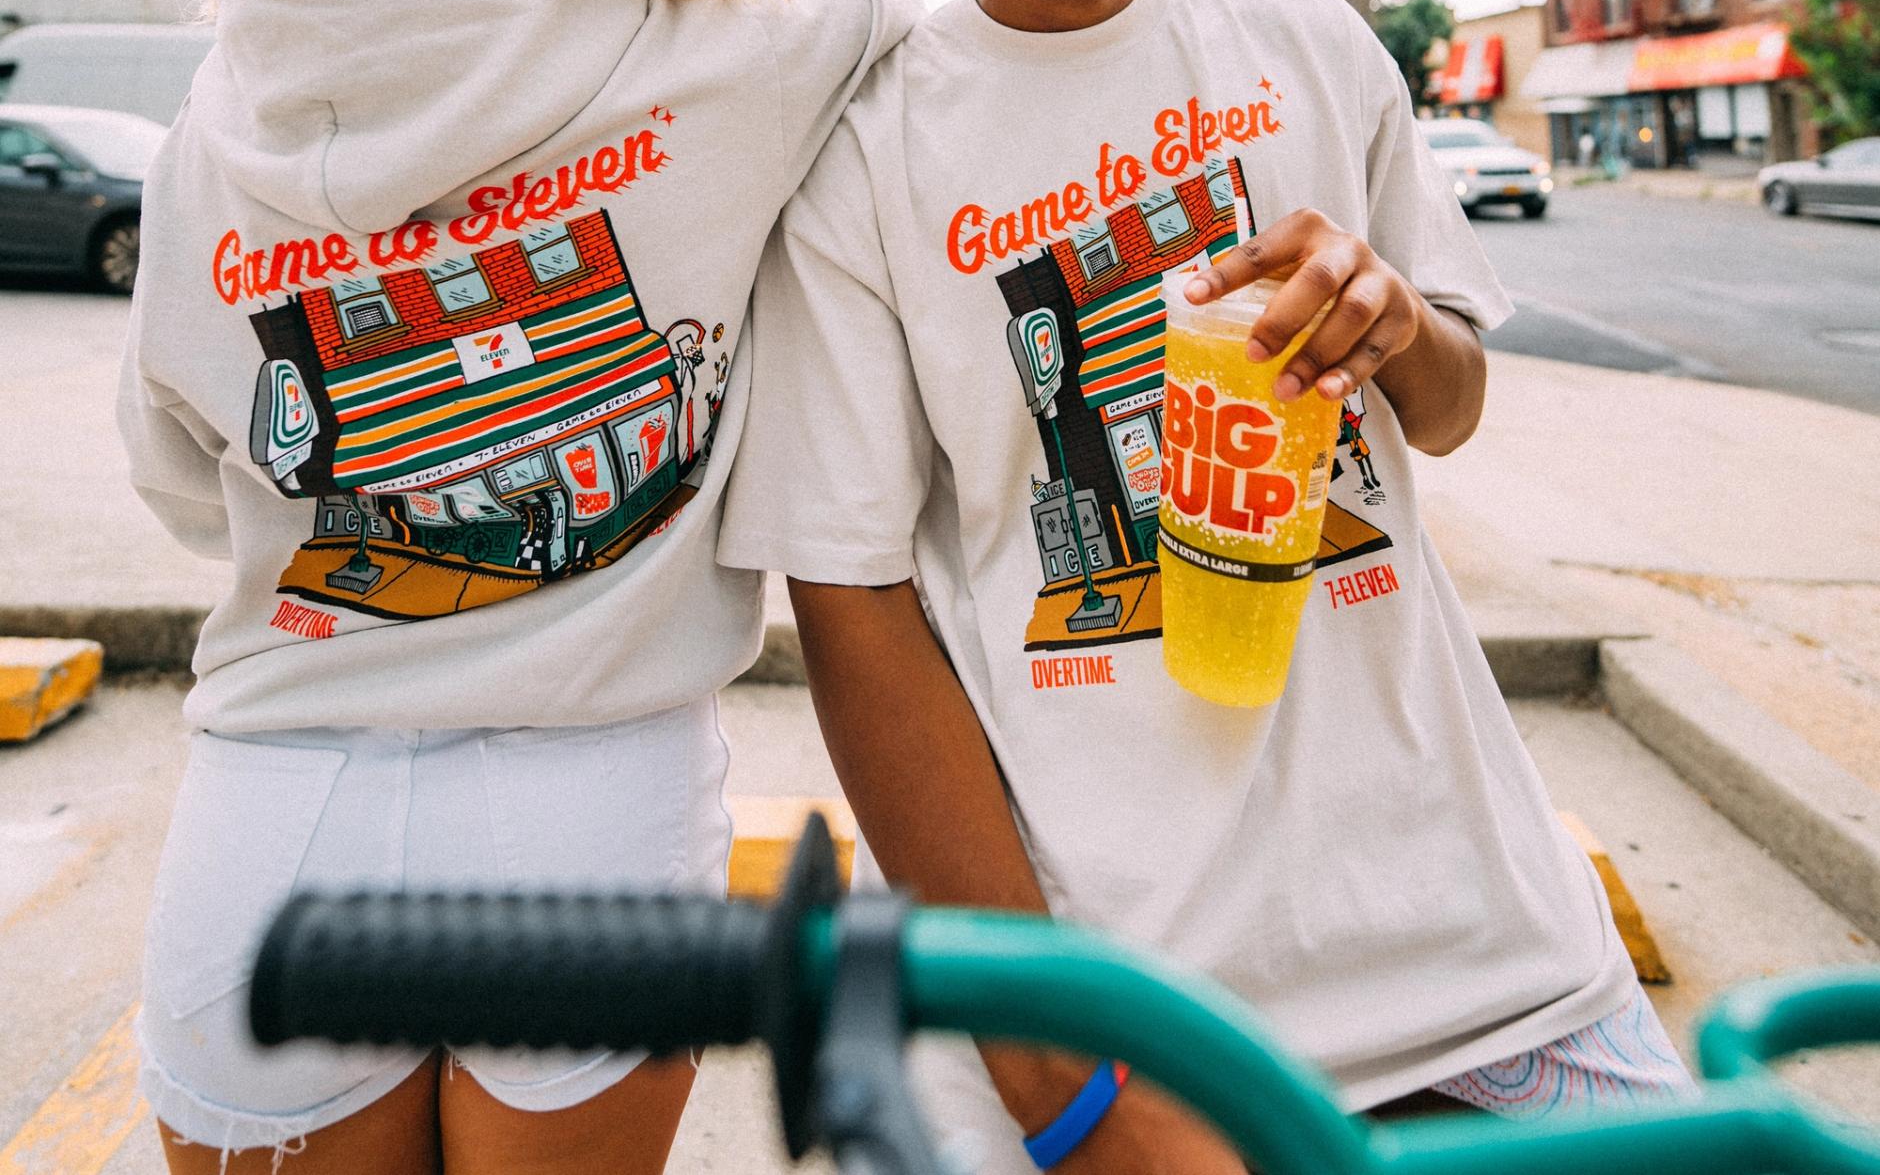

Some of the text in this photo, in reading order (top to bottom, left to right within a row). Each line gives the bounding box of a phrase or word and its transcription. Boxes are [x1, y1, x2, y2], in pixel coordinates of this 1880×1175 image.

[213, 129, 672, 306] Game to Eleven
[946, 182, 1098, 274] Game
[1096, 142, 1147, 208] to
[1145, 389, 1165, 402] Eleve
[1050, 483, 1065, 496] ICE
[325, 509, 384, 535] ICE
[1049, 544, 1104, 577] ICE
[1178, 545, 1209, 567] EXTRA
[1210, 557, 1249, 576] LARGE
[1323, 564, 1399, 609] 7-ELEVEN
[270, 600, 338, 639] OVERTIME
[1031, 655, 1116, 689] OVERTIME
